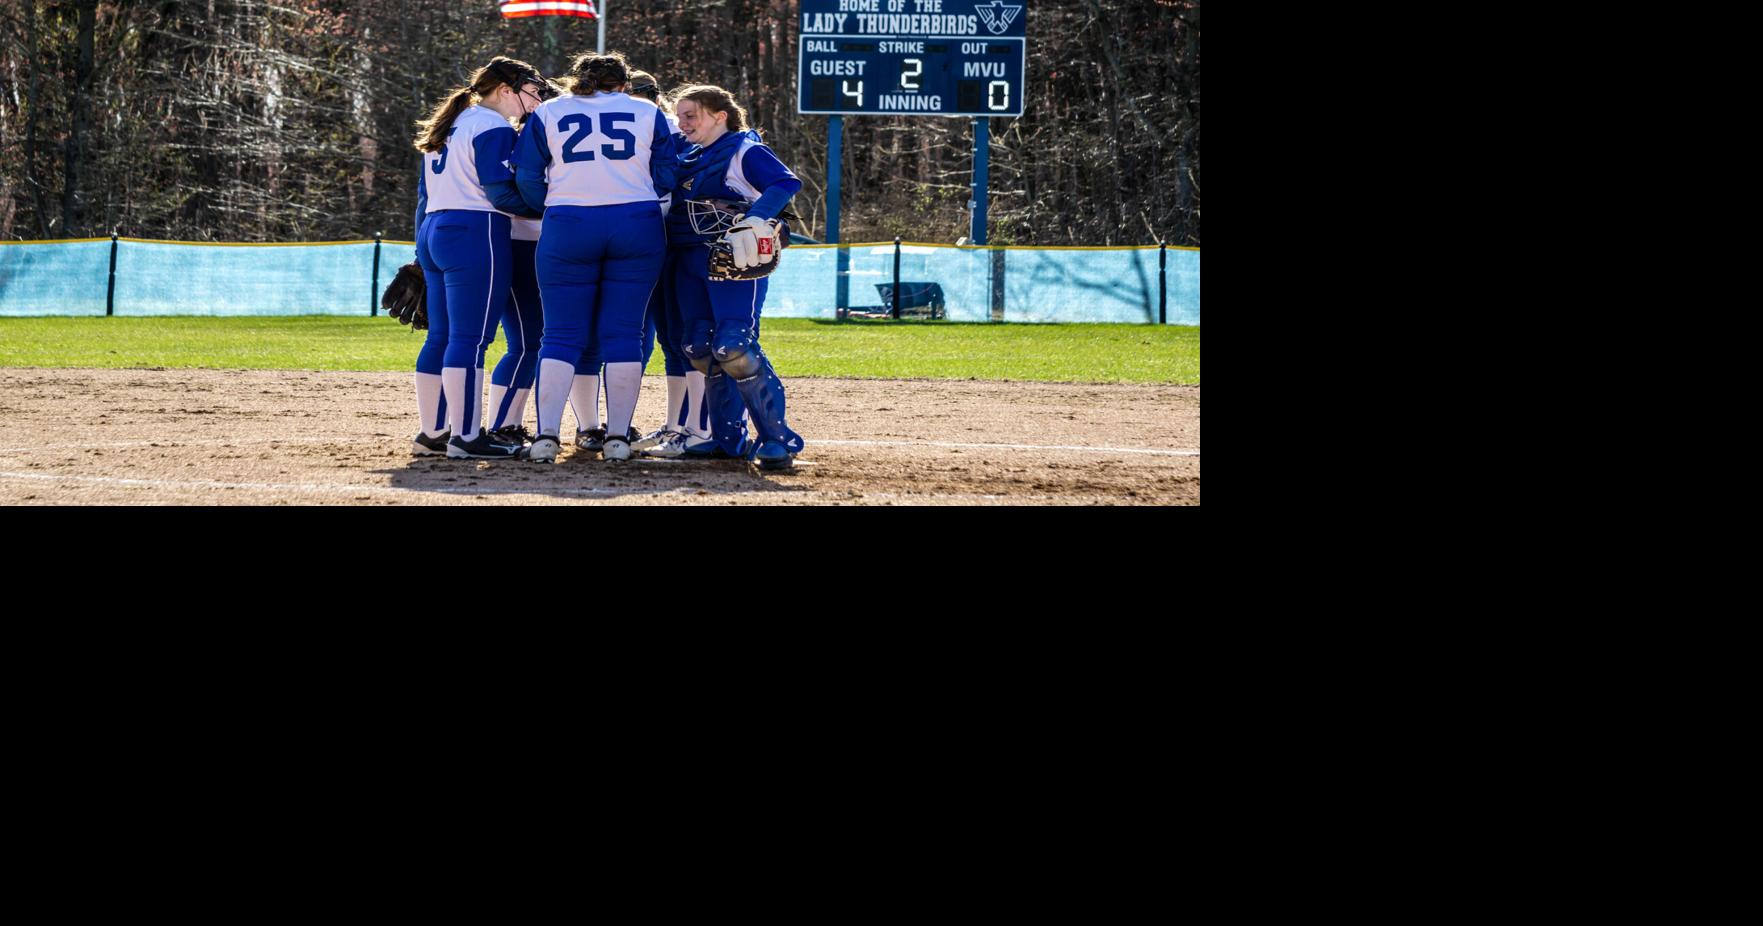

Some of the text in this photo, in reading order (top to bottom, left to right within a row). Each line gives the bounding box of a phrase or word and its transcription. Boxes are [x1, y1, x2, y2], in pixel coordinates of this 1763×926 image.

[839, 0, 942, 12] HOME OF THE
[803, 13, 978, 34] LADY THUNDERBIRDS
[807, 41, 837, 52] BALL
[879, 41, 924, 53] STRIKE
[961, 43, 988, 54] OUT
[810, 60, 866, 75] GUEST
[901, 59, 922, 88] 2
[964, 62, 1006, 77] MVU
[842, 80, 864, 107] 4
[988, 80, 1009, 110] 0
[879, 95, 941, 110] INNING
[557, 112, 636, 163] 25
